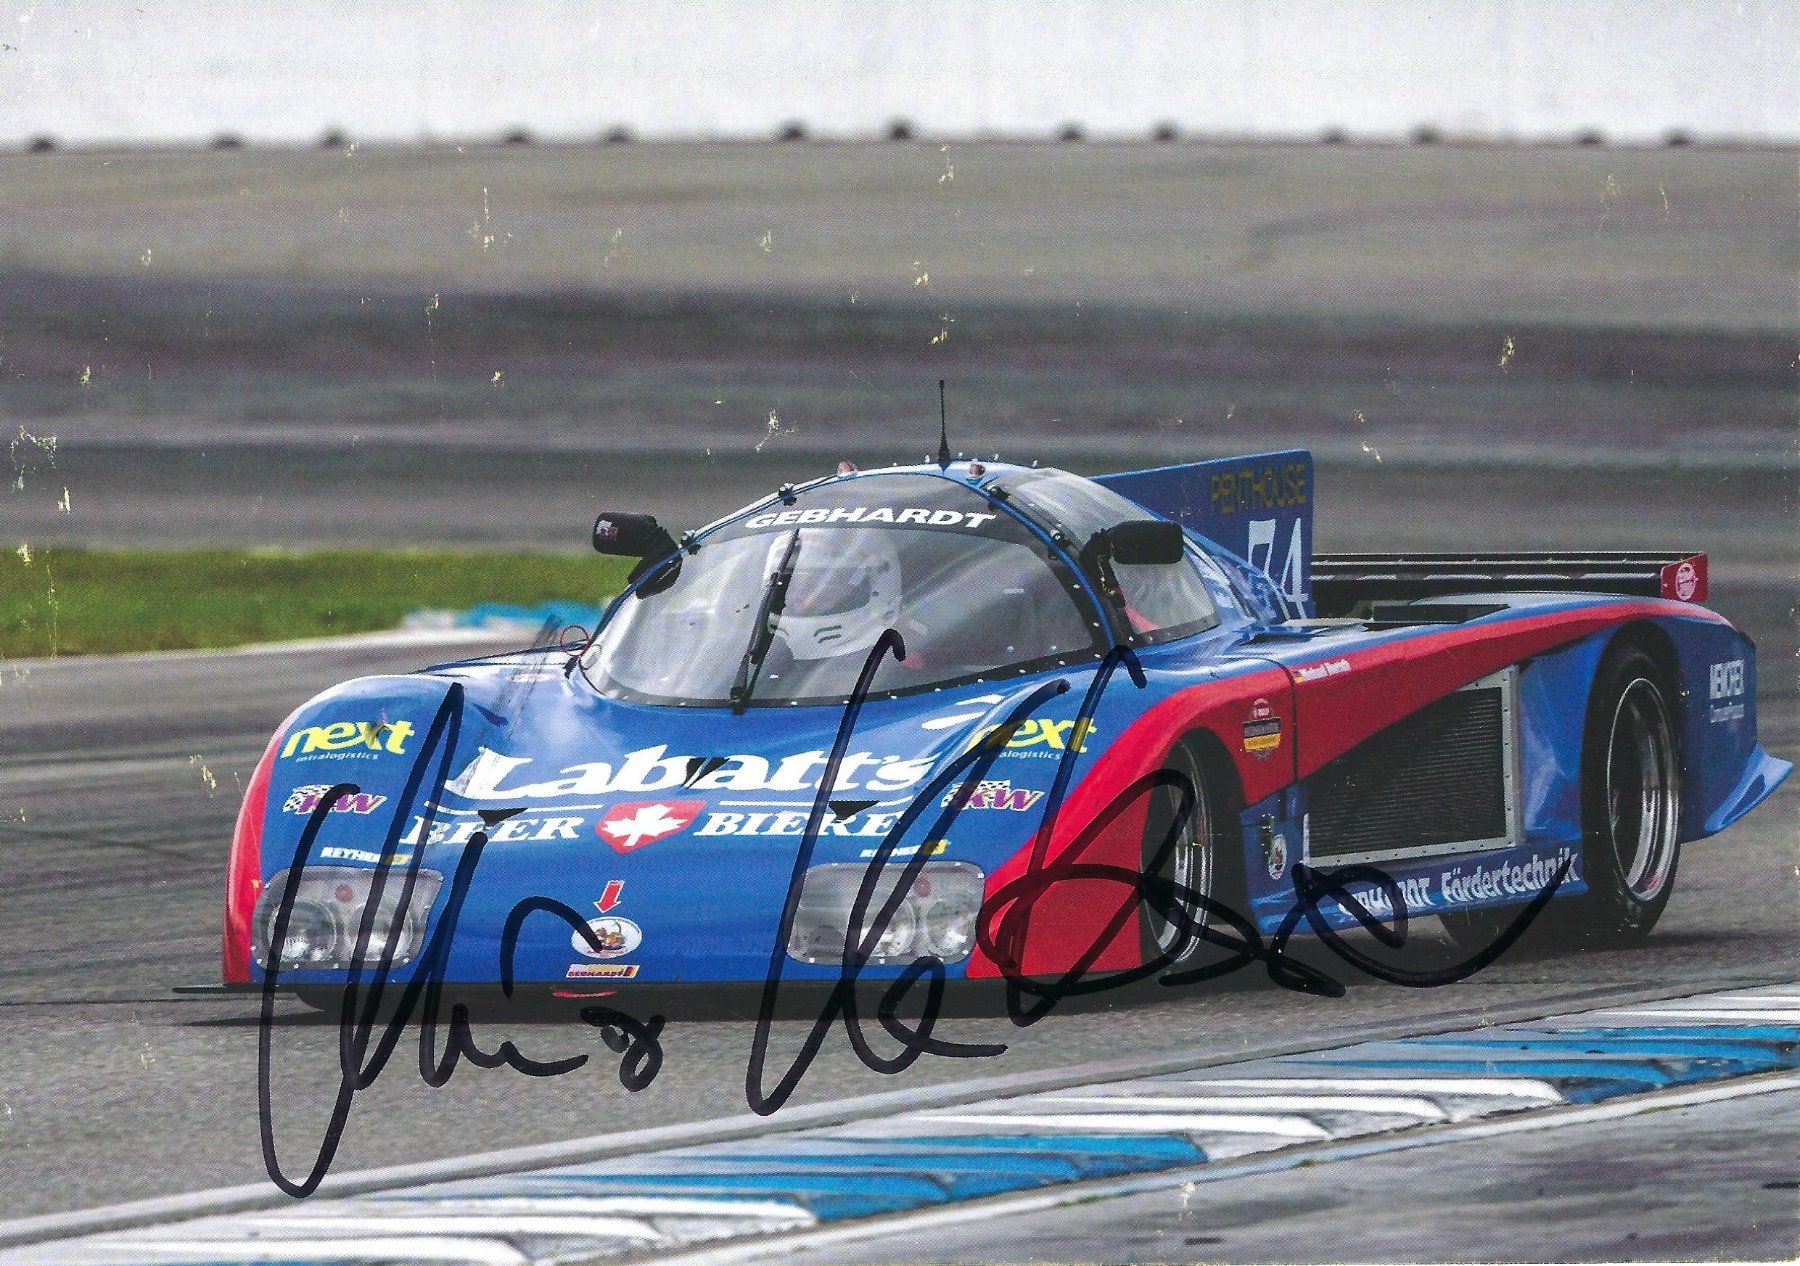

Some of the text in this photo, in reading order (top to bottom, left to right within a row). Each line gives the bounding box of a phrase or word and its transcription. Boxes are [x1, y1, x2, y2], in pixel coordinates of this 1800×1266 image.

[1210, 463, 1308, 515] PENTHOUSE
[745, 507, 997, 529] GEBHARDT
[1248, 517, 1309, 603] 74
[281, 720, 415, 758] next
[444, 744, 942, 800] Labatt's
[1441, 847, 1580, 903] Fördertechnik
